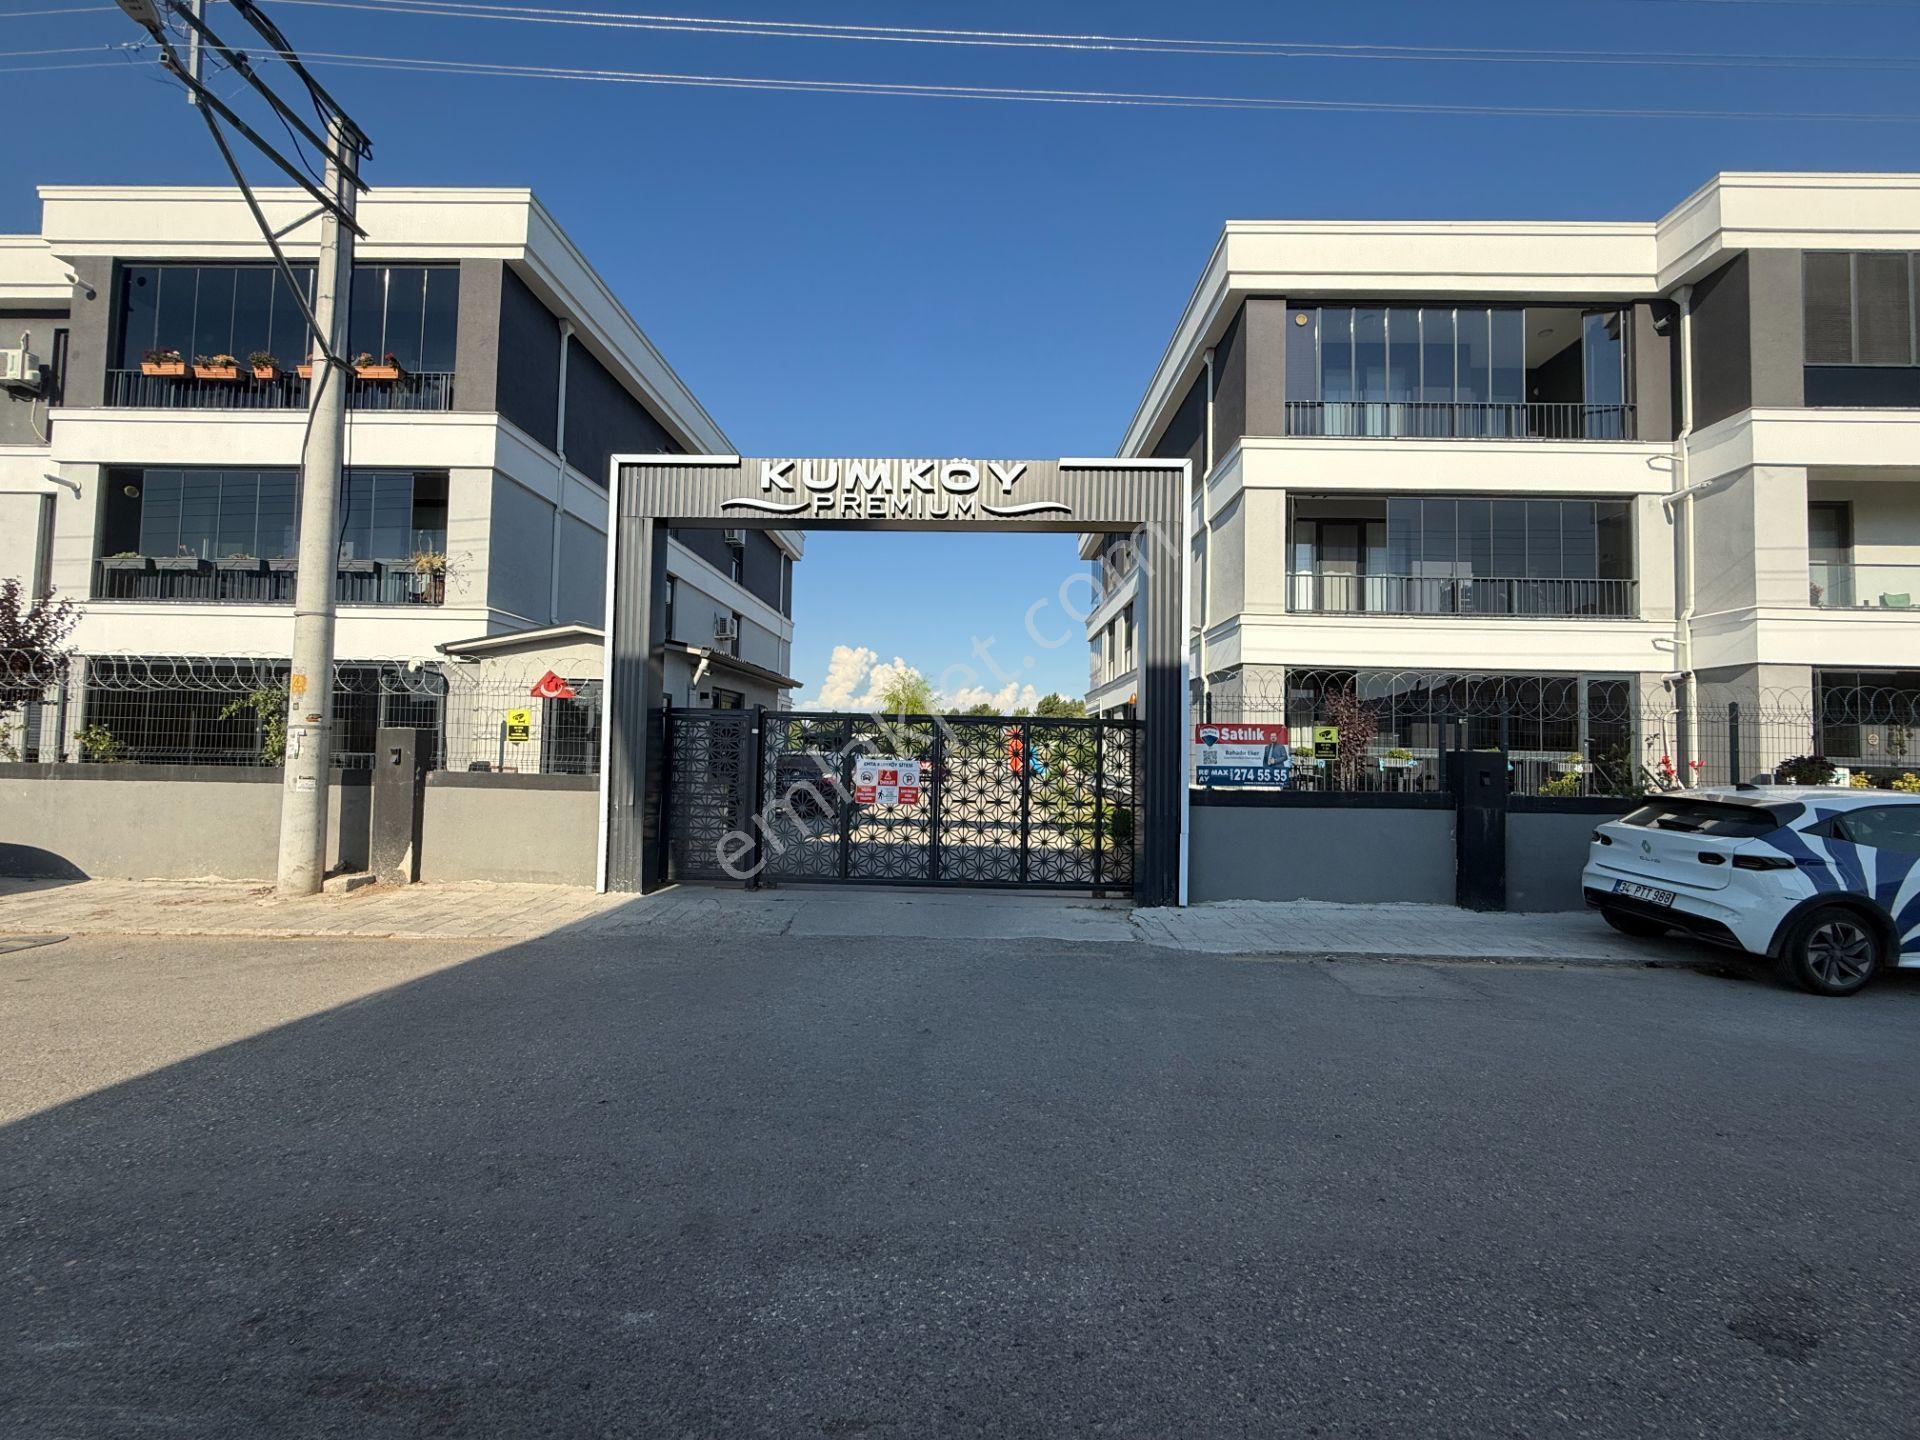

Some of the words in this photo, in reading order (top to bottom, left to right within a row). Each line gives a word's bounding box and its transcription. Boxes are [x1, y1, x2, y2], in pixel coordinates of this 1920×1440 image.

[760, 457, 1027, 494] KUMKÖY
[1221, 727, 1264, 740] Satılık
[1234, 768, 1254, 780] 274
[1257, 769, 1271, 781] 55
[1273, 769, 1287, 781] 55
[1652, 890, 1672, 903] 988
